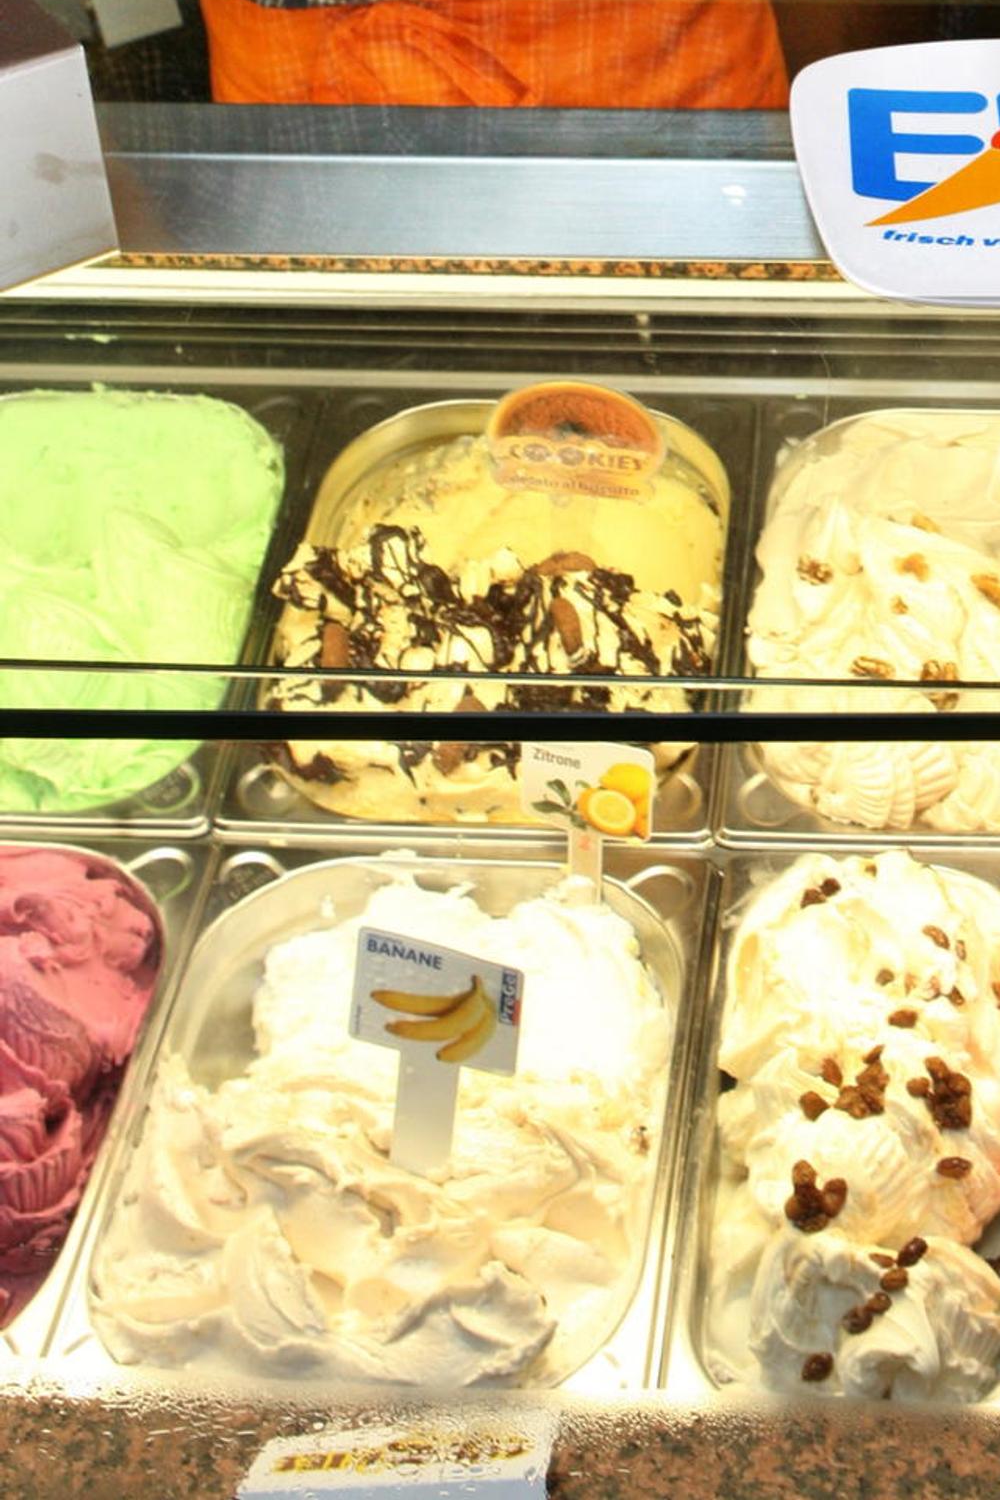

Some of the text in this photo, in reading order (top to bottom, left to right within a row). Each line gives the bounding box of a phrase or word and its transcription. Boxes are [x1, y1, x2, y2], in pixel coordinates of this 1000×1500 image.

[882, 228, 974, 247] frisch
[532, 748, 581, 769] Zitrone
[366, 937, 444, 970] BANANE
